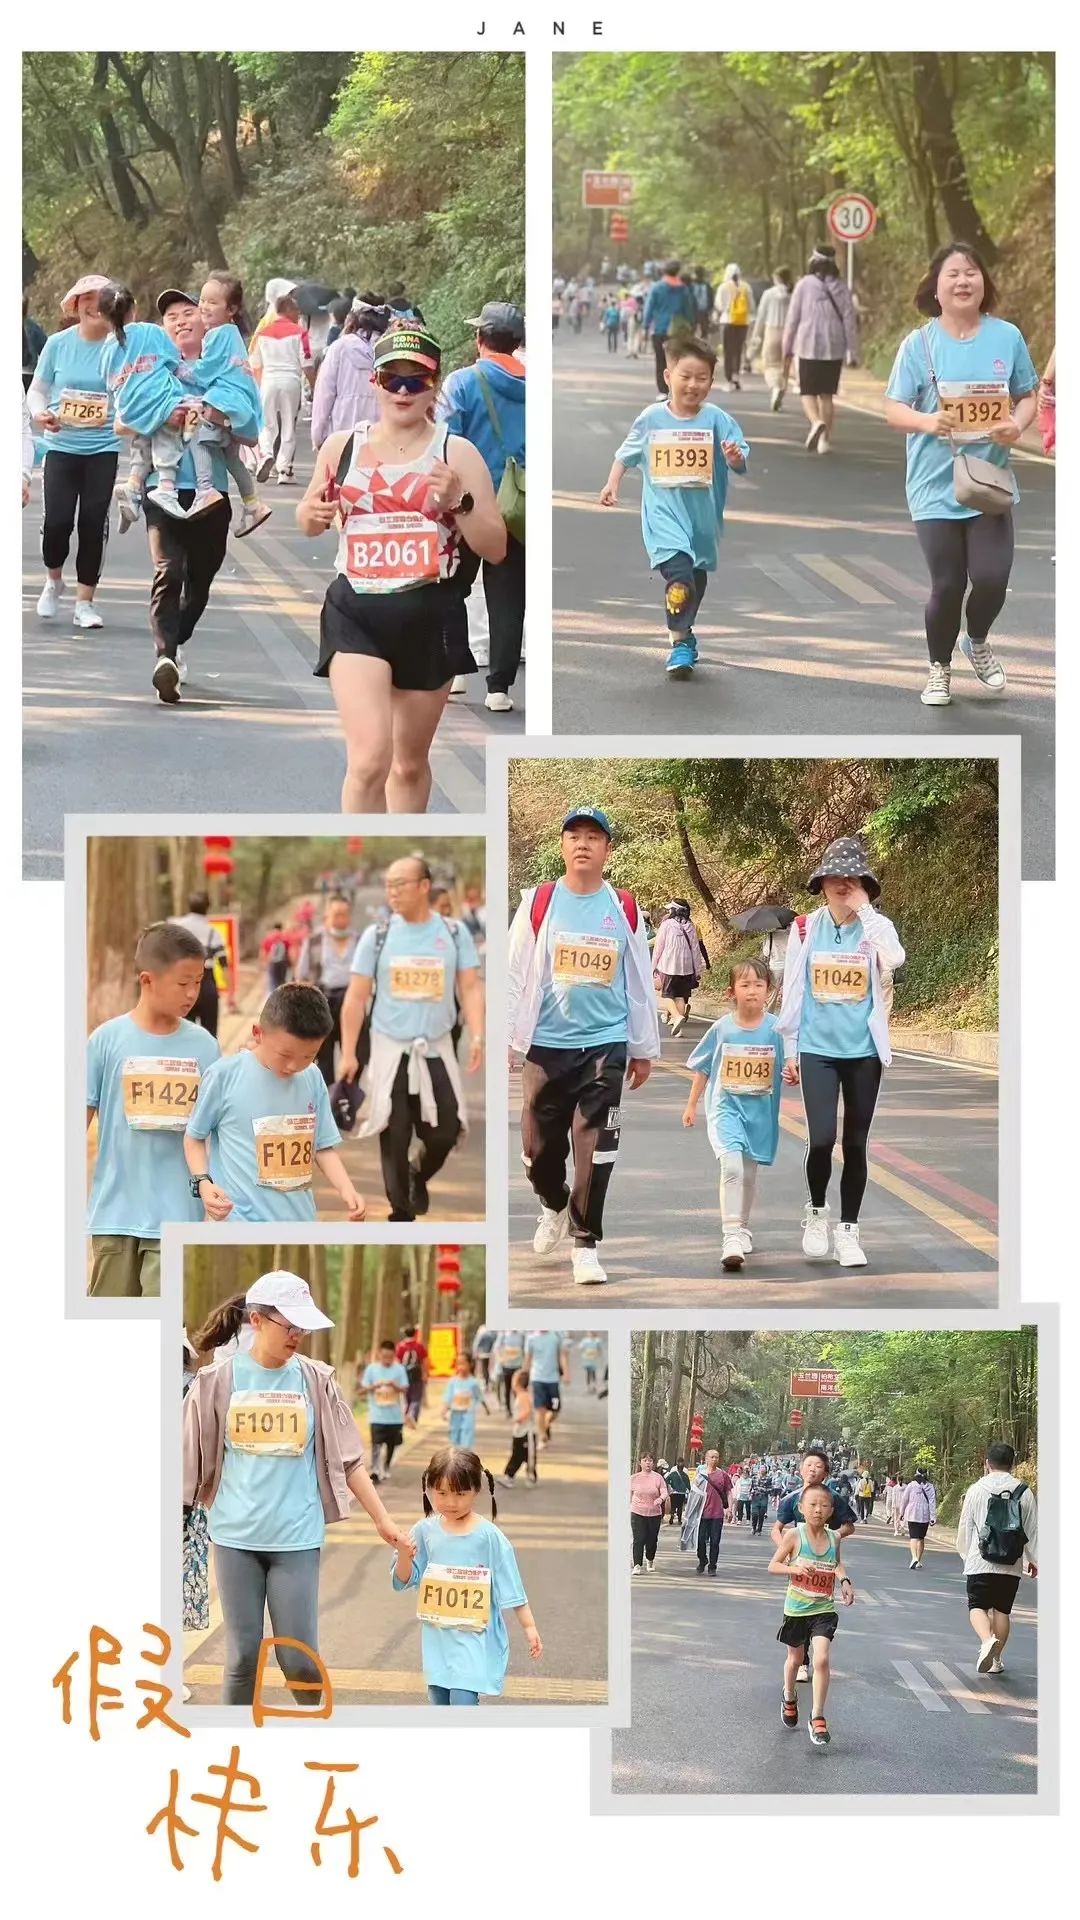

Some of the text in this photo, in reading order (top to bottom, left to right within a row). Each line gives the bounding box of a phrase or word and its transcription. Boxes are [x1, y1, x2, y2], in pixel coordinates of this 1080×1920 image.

[840, 207, 863, 229] 30
[392, 342, 420, 350] HAWAII
[393, 336, 420, 344] KONA
[63, 402, 103, 419] F1265
[655, 448, 708, 468] F1393
[353, 539, 430, 568] B2061
[560, 949, 612, 971] F1049
[814, 969, 863, 987] F1042
[726, 1060, 770, 1078] F1043
[131, 1081, 199, 1106] F1424
[235, 1412, 298, 1433] F1011
[423, 1584, 484, 1610] F1012
